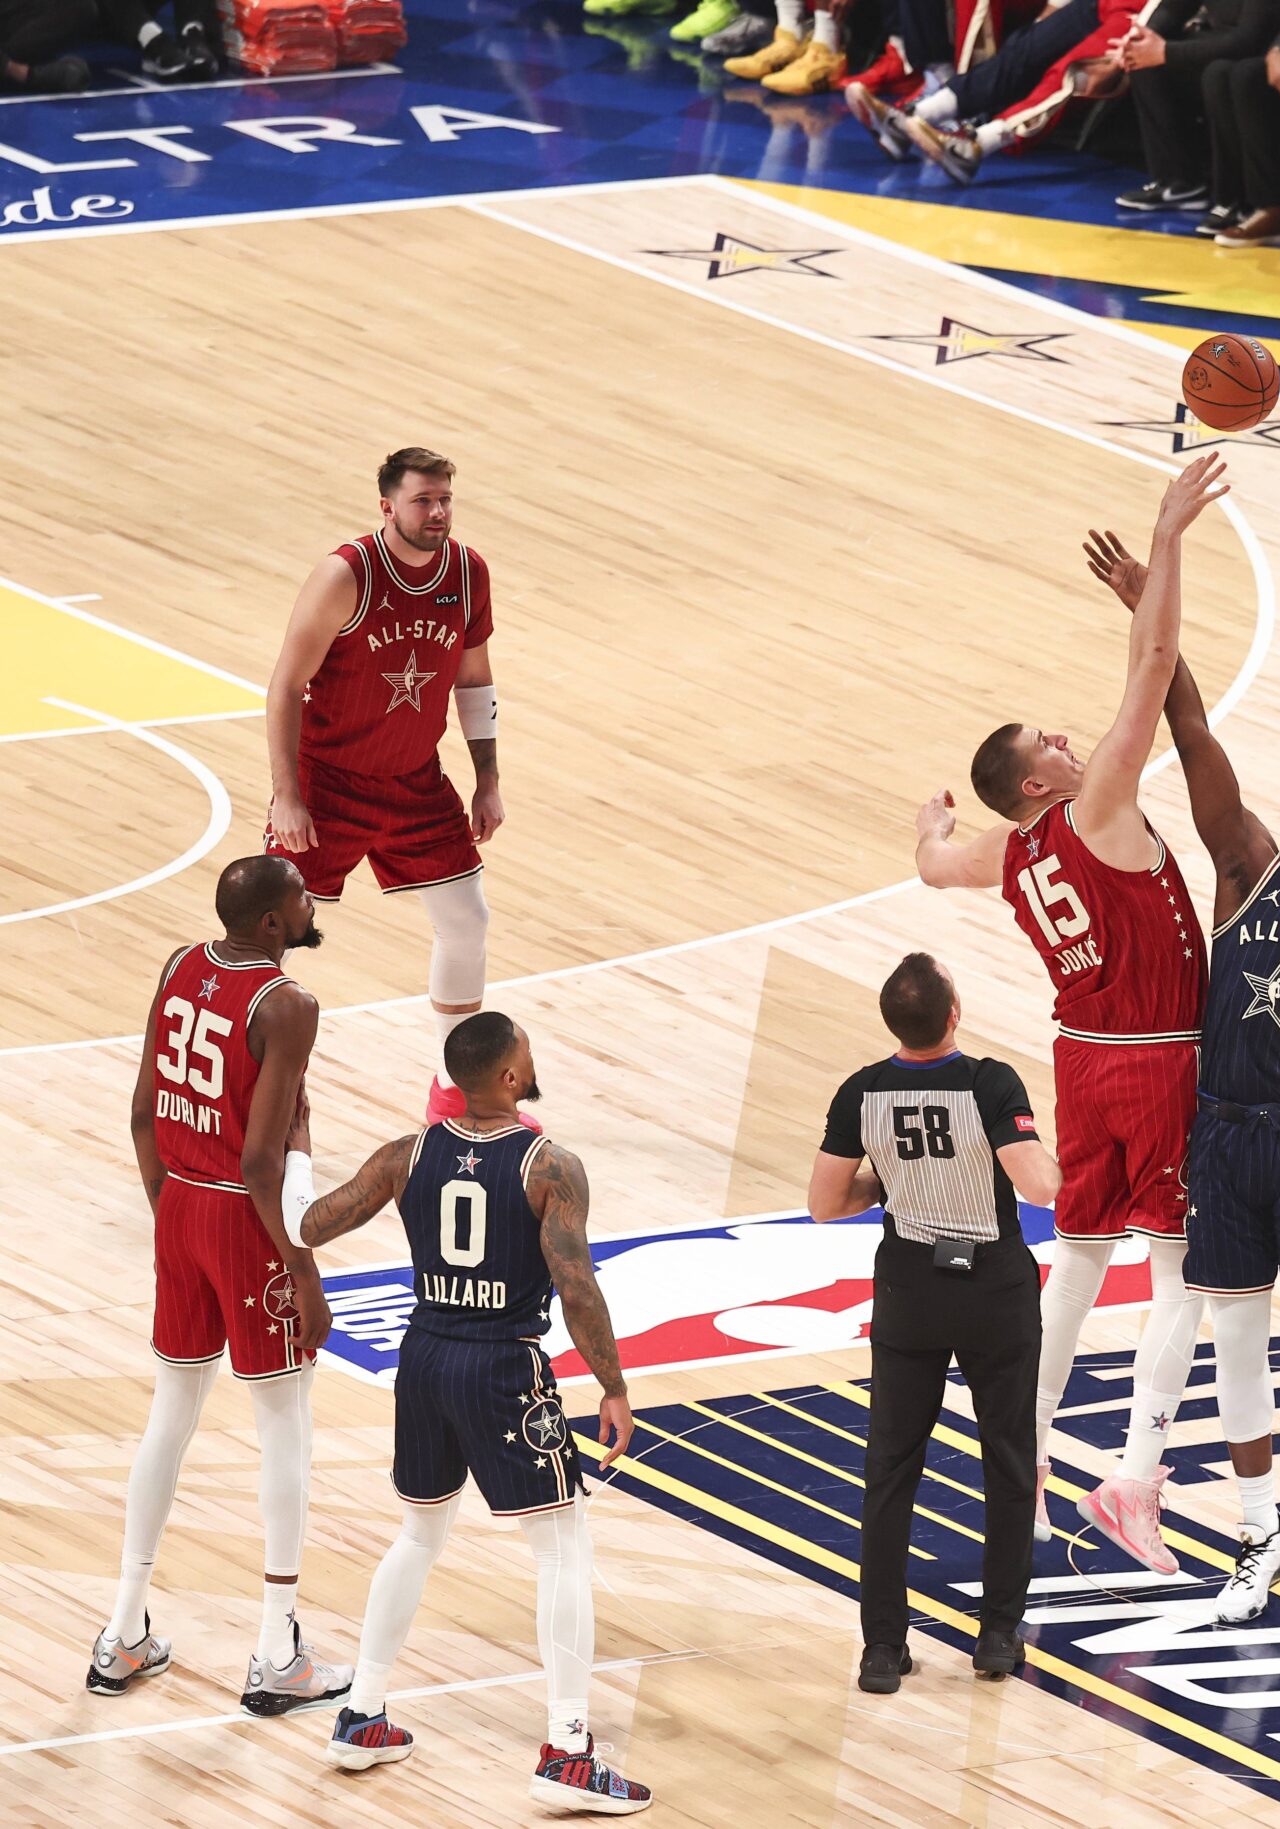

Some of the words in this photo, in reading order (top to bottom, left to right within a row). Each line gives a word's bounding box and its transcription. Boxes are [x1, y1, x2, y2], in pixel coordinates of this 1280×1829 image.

[367, 619, 459, 652] ALL-STAR
[1017, 853, 1091, 948] 15
[157, 995, 234, 1100] 35
[893, 1105, 956, 1160] 58
[440, 1179, 487, 1268] 0
[324, 1283, 418, 1352] NBA
[423, 1273, 506, 1309] LILLARD
